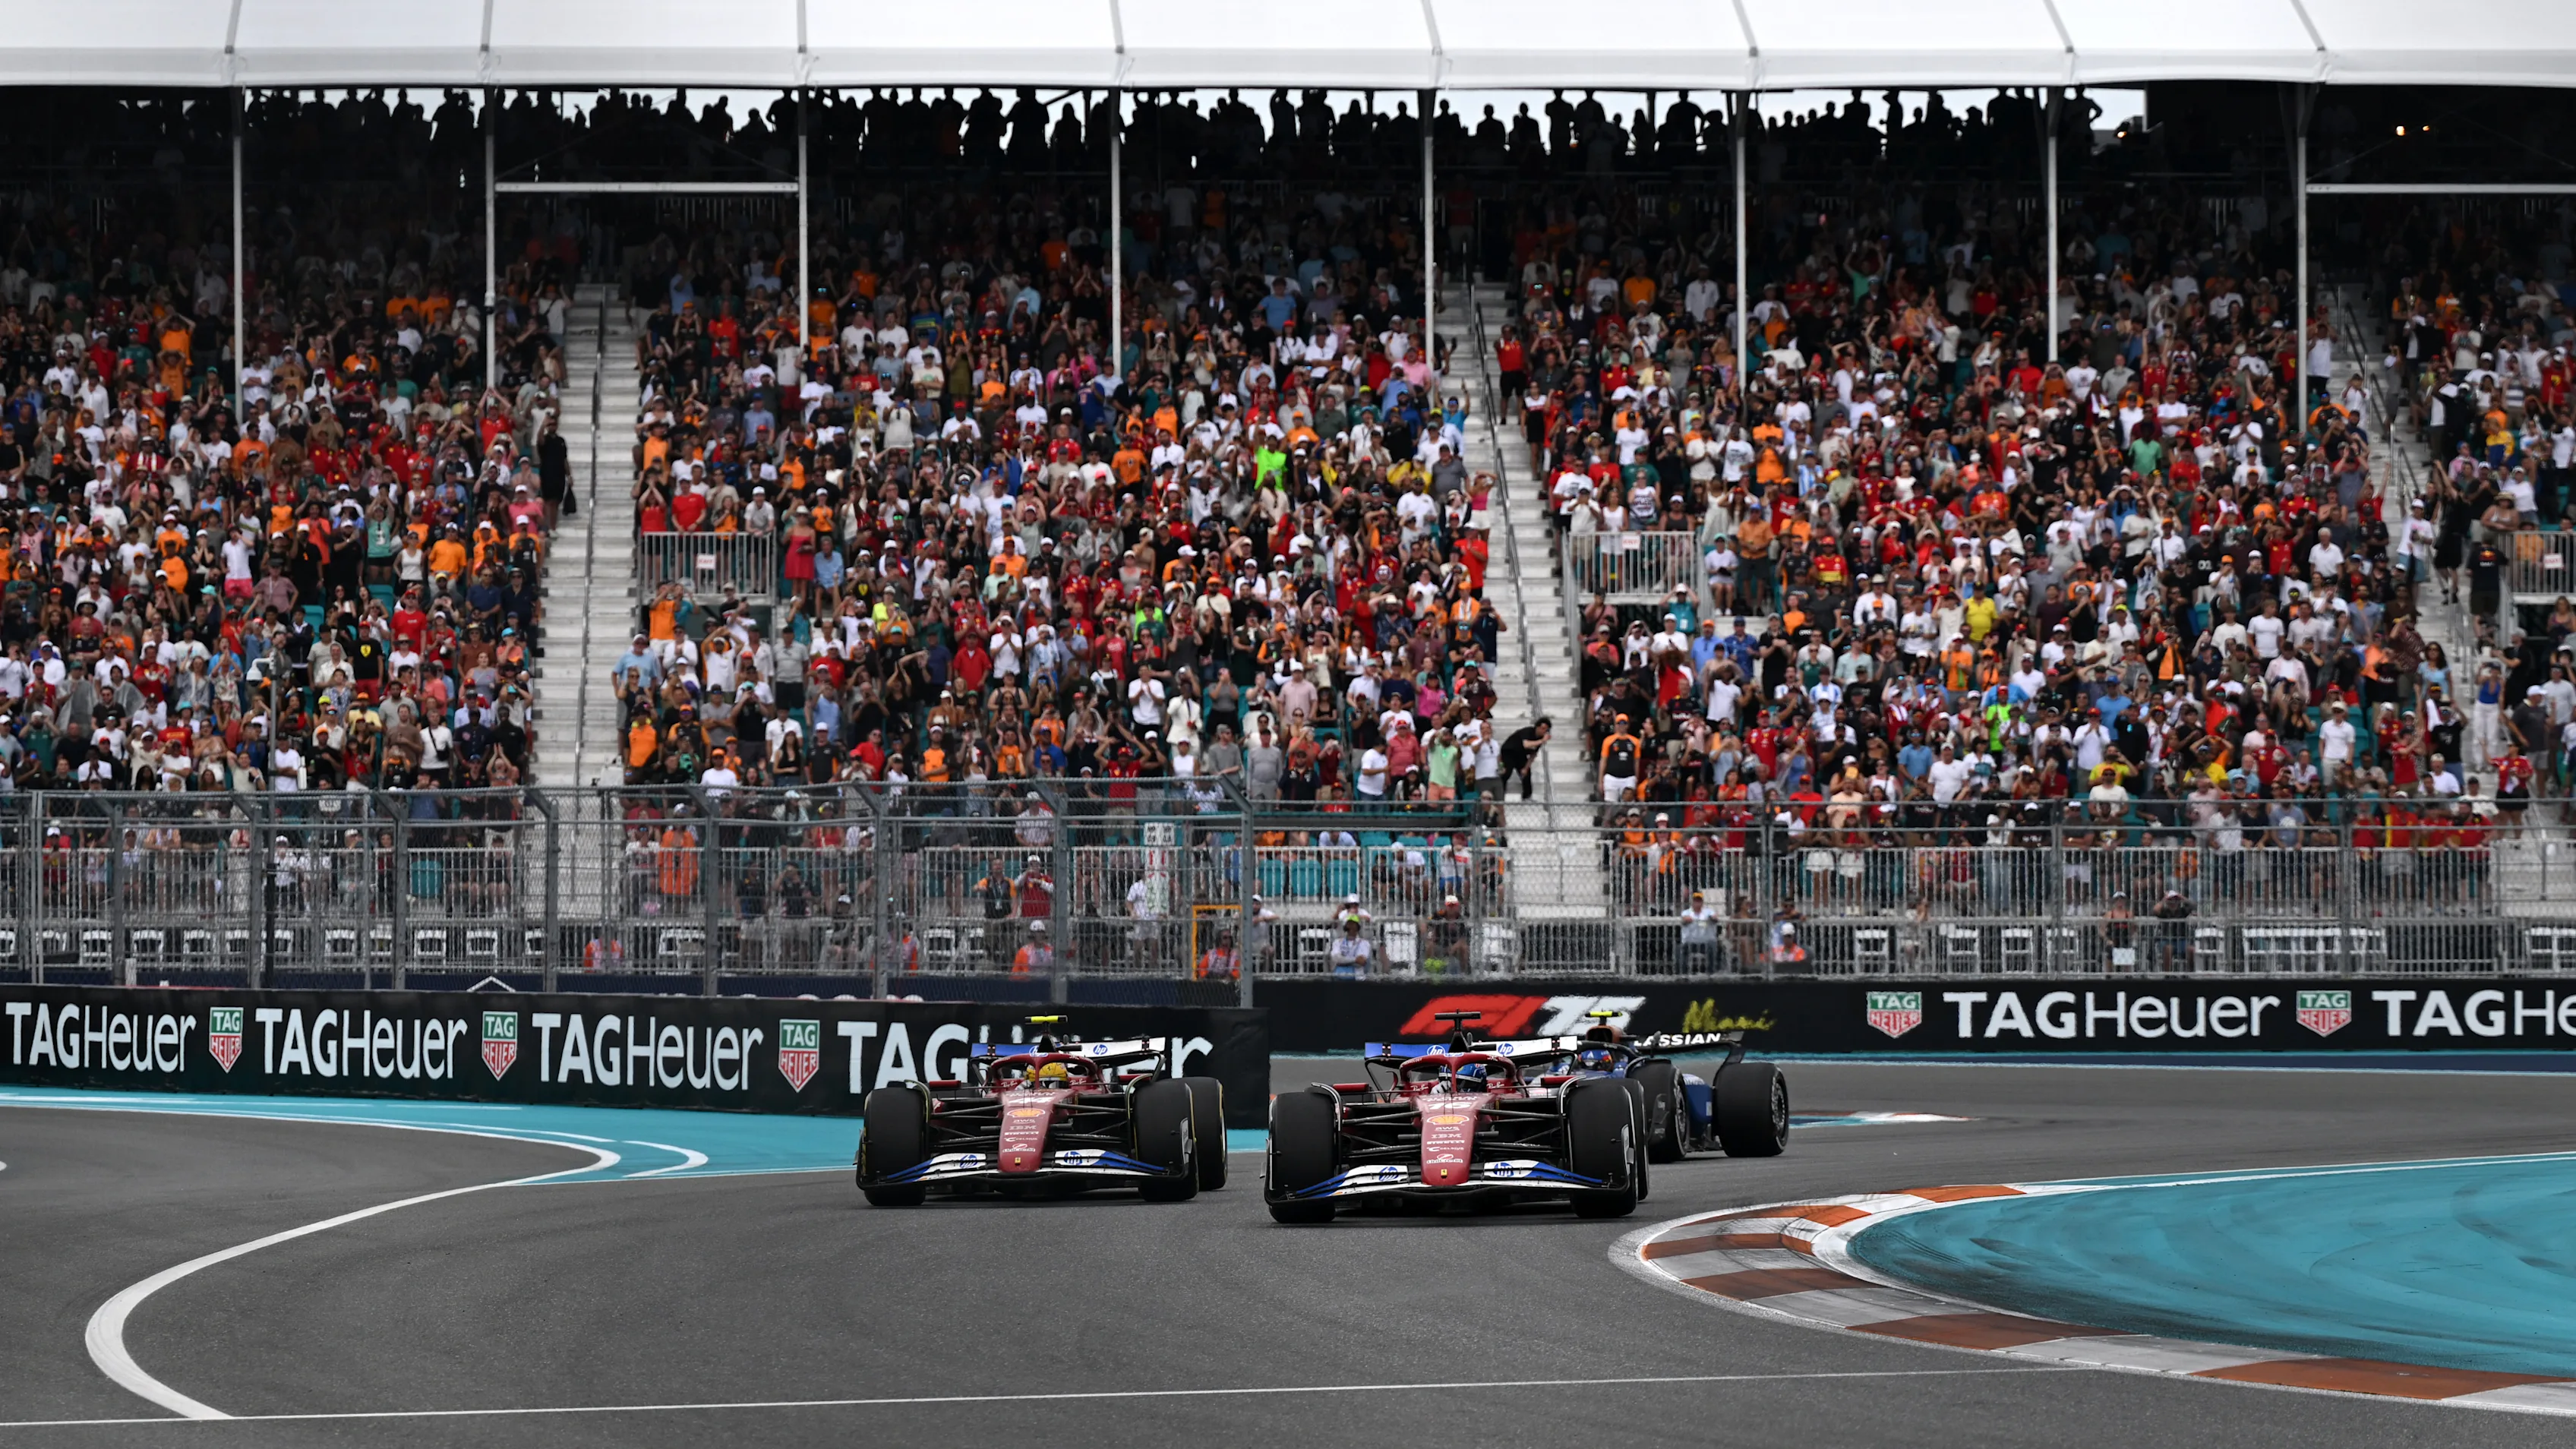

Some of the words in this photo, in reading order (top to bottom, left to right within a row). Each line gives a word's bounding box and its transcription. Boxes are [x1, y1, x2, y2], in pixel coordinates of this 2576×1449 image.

[1871, 995, 1916, 1009] TAG
[2301, 993, 2347, 1008] TAG
[213, 1012, 240, 1031] TAG
[485, 1016, 514, 1037] TAG
[1870, 1012, 1919, 1033] HEUER
[2300, 1011, 2348, 1032] HEUER
[783, 1024, 816, 1046] TAG
[211, 1037, 241, 1068] HEUER
[484, 1043, 515, 1075] HEUER
[1093, 1043, 1108, 1056] hp
[1428, 1045, 1444, 1056] hp
[1498, 1043, 1514, 1056] hp
[781, 1053, 816, 1085] HEUER
